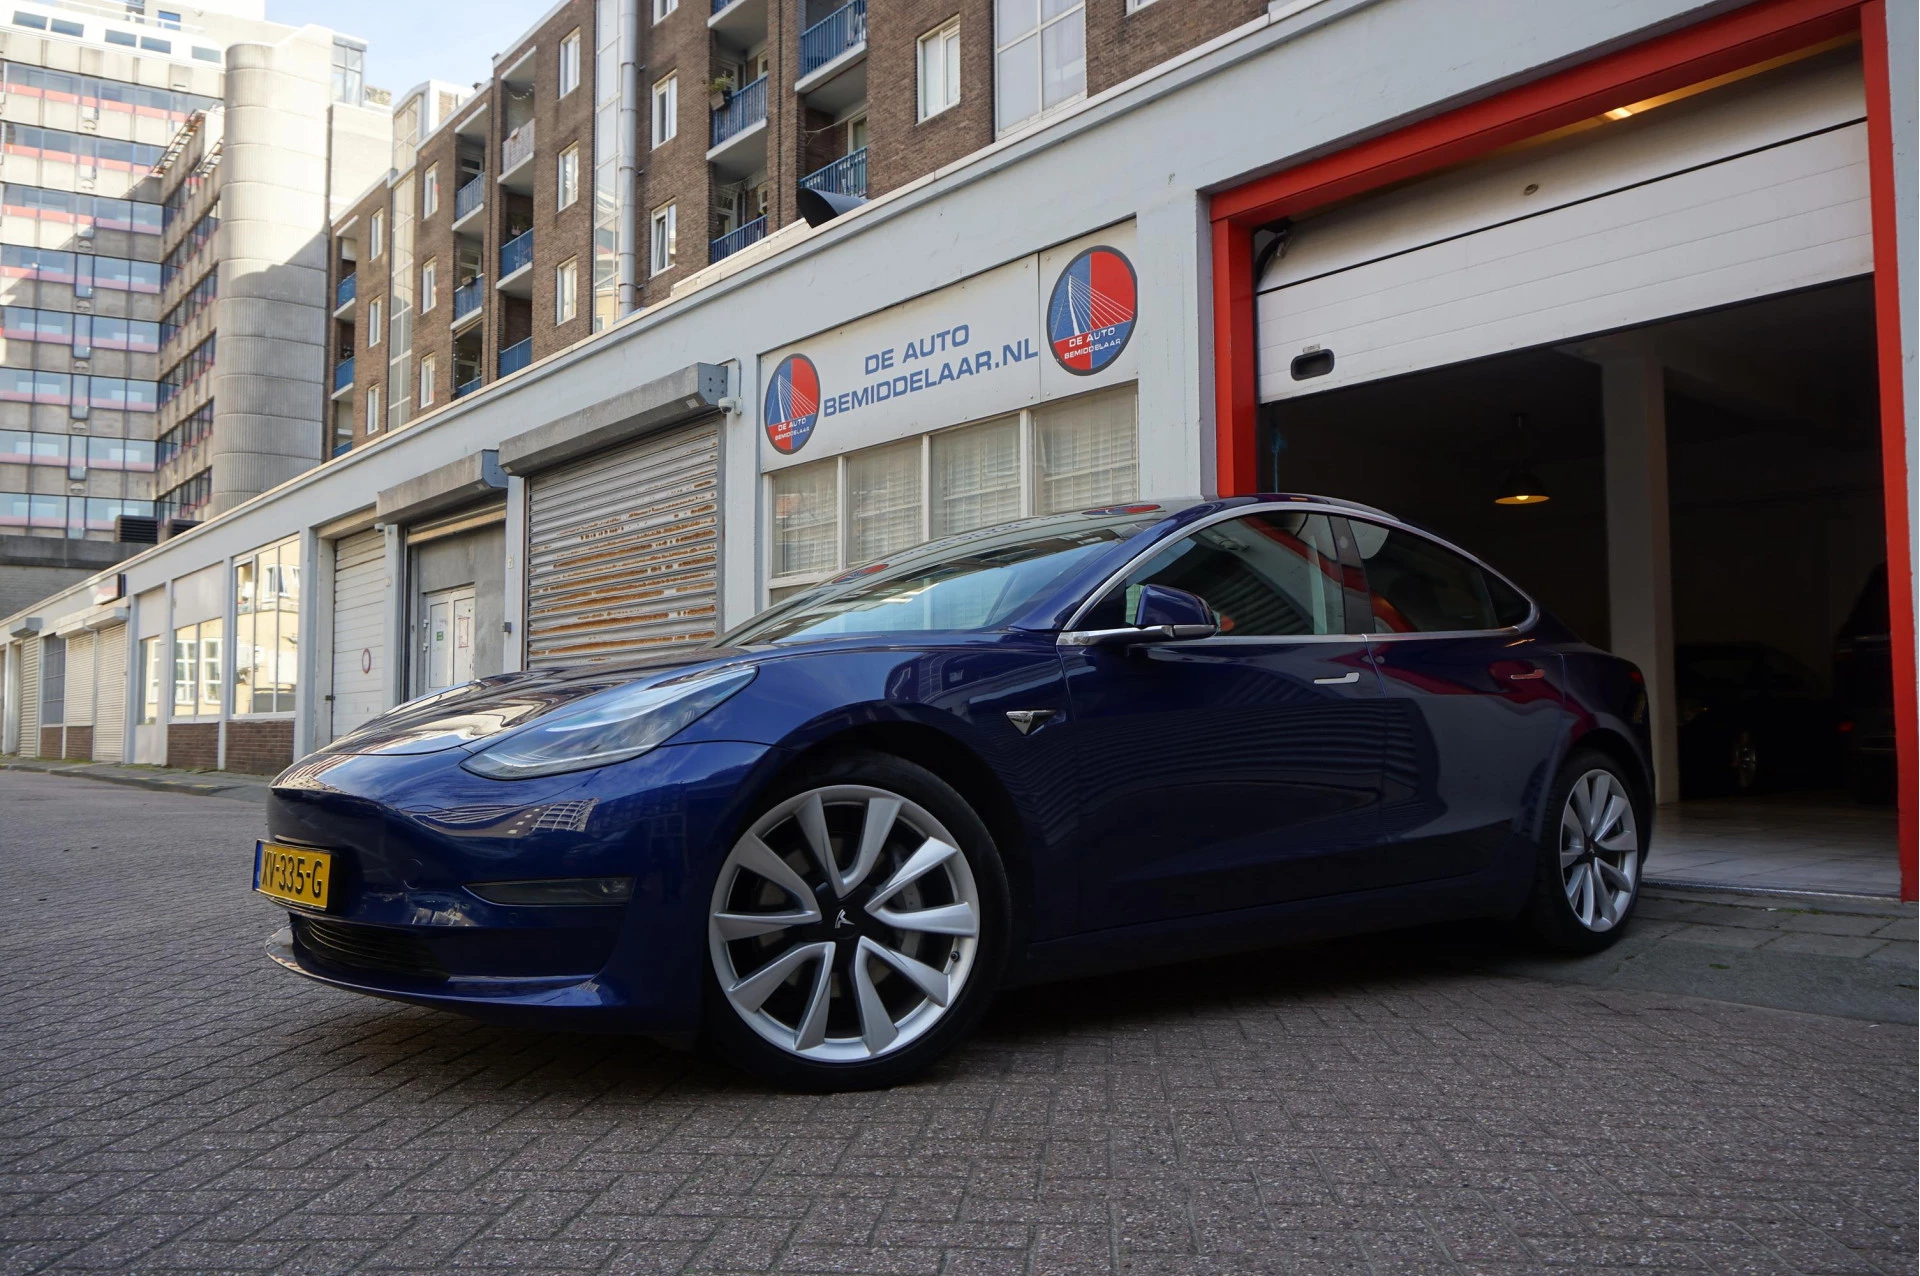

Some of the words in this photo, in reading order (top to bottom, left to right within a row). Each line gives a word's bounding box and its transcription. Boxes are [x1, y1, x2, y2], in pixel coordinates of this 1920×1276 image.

[865, 348, 894, 375] DE
[902, 324, 970, 364] AUTO
[1064, 338, 1121, 360] BEMIDDELAAR
[1069, 336, 1083, 348] DE
[1087, 327, 1115, 342] AUTO
[823, 338, 1039, 417] BEMIDDELAAR.NL
[777, 423, 787, 432] DE
[788, 417, 807, 428] AUTO
[262, 849, 323, 898] XV-335-G
